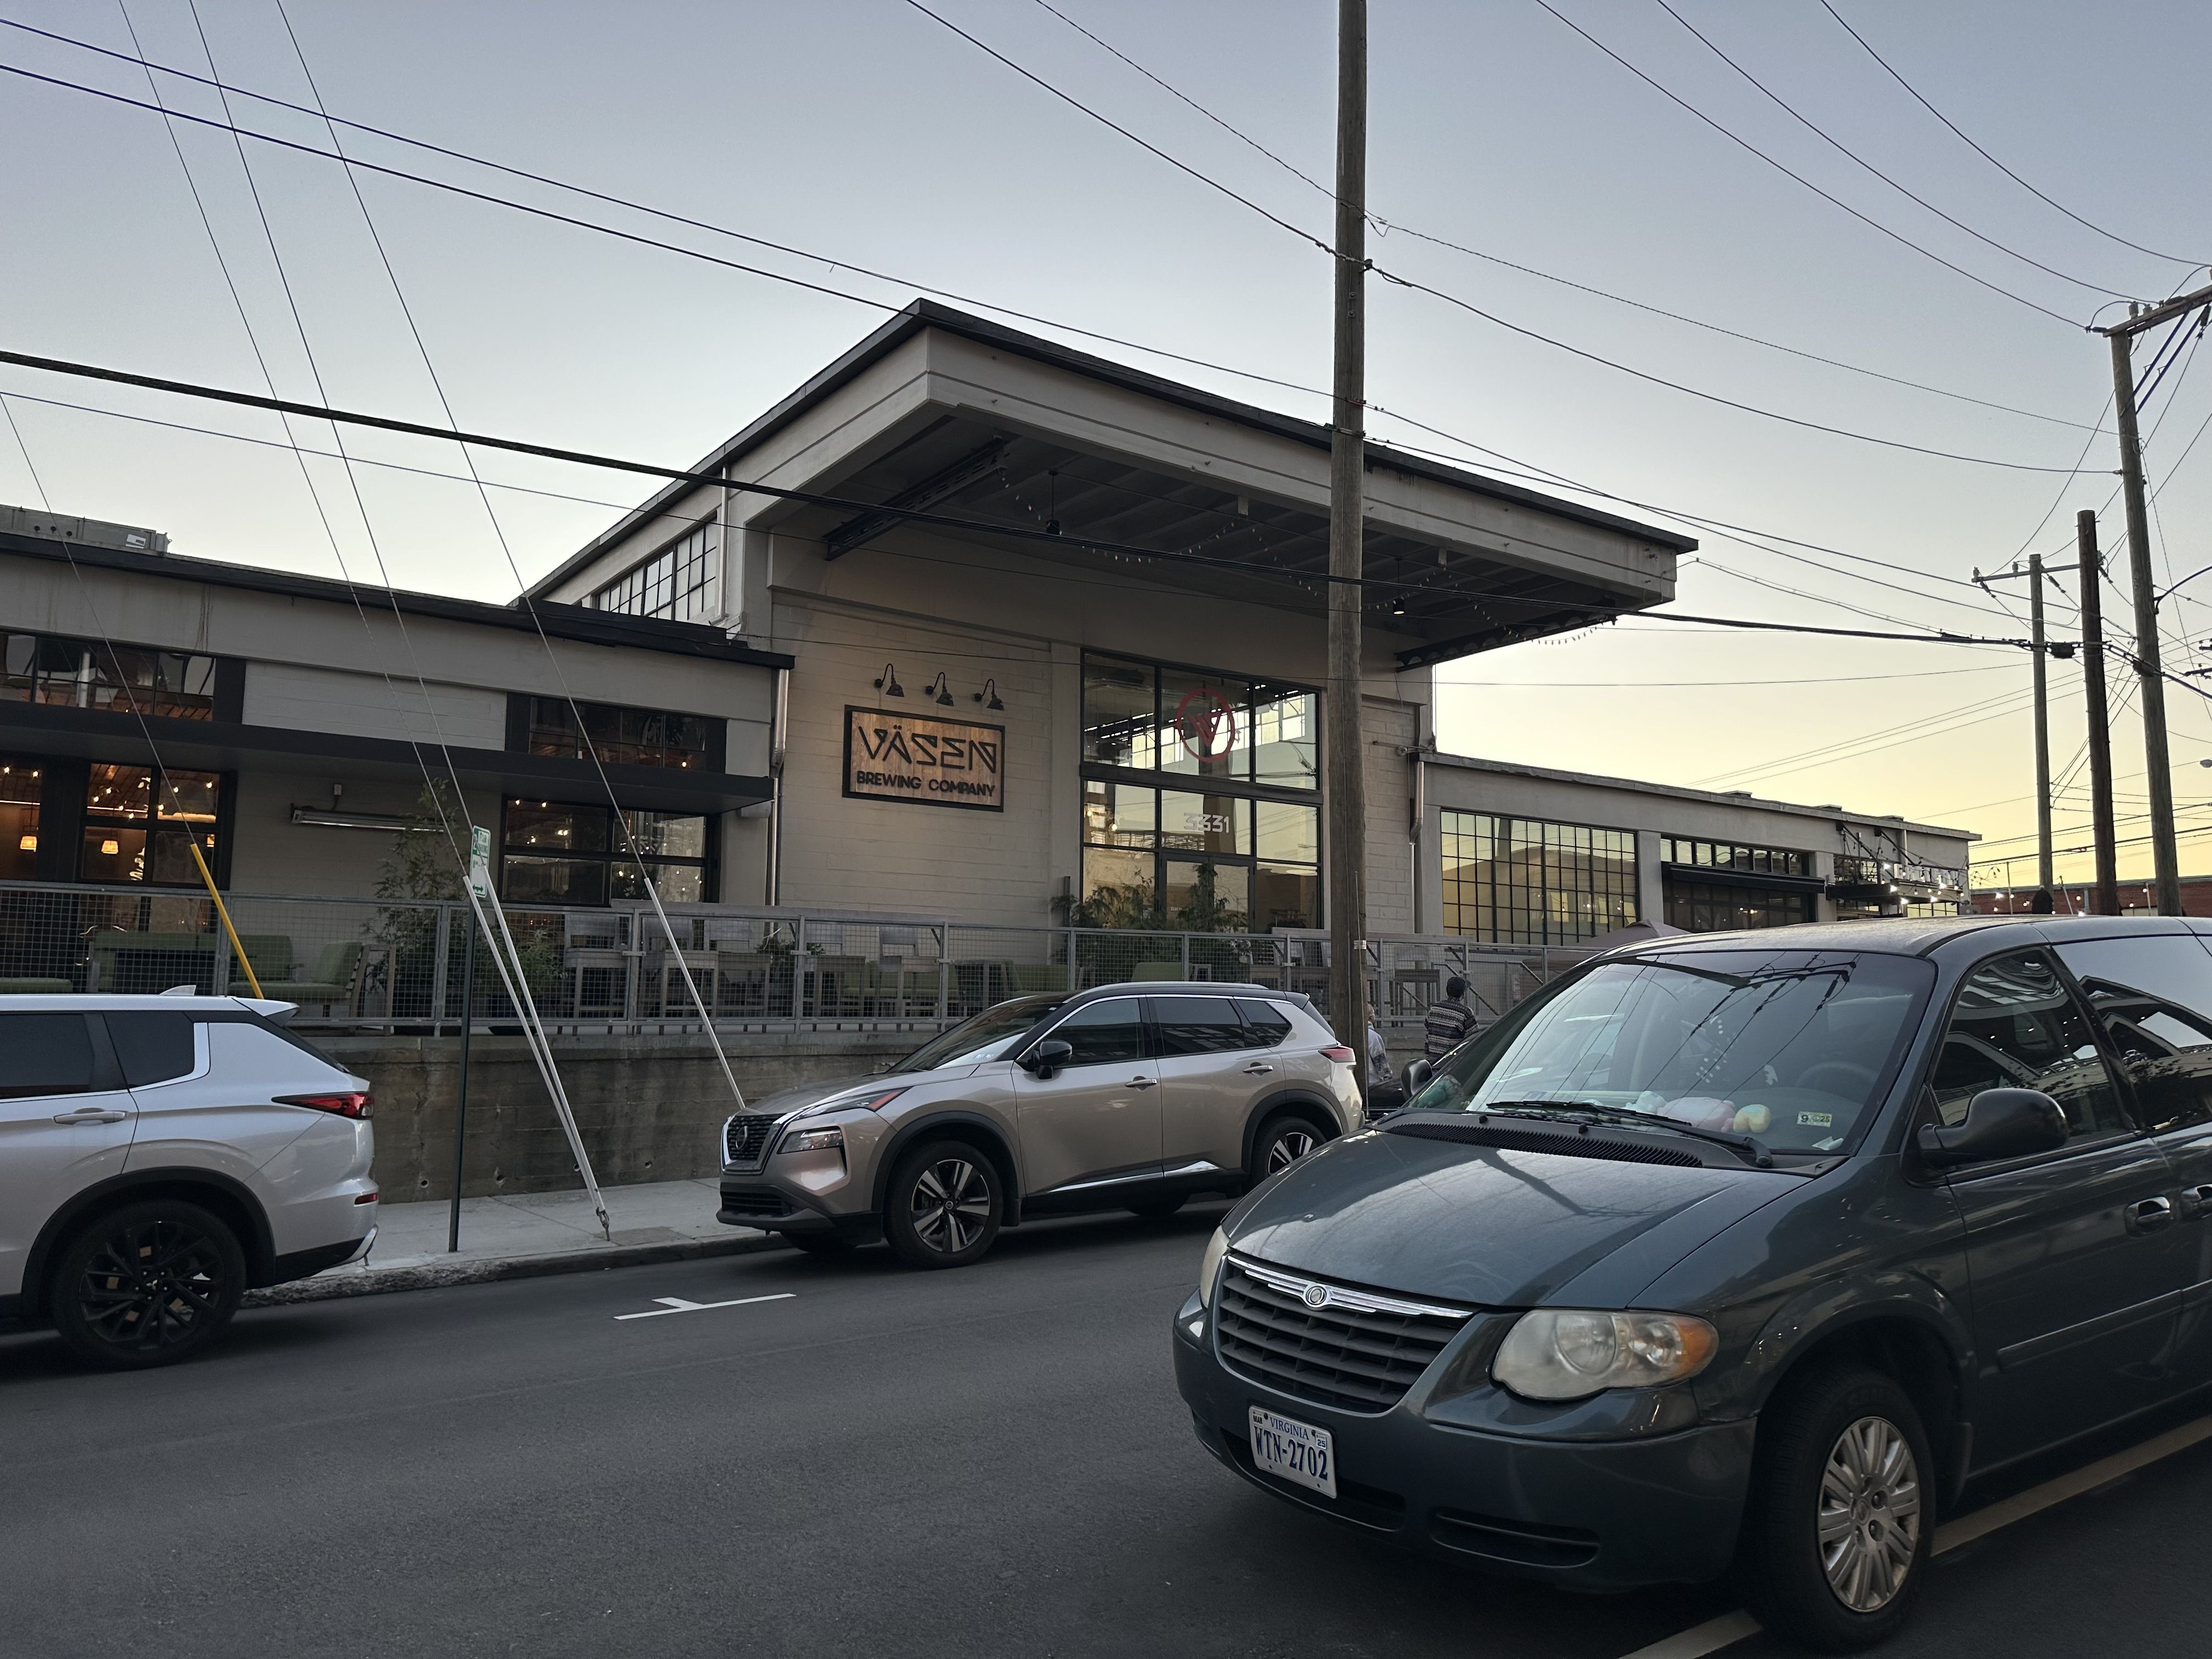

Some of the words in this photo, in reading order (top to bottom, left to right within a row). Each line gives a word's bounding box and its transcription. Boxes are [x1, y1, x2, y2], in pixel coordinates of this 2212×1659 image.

[858, 725, 997, 774] VÄSEN
[857, 771, 921, 789] BREWING
[929, 778, 995, 796] COMPANY
[1184, 813, 1229, 833] 3331
[1801, 1114, 1809, 1122] 9
[1270, 1417, 1310, 1440] VIRGINIA
[1254, 1425, 1328, 1481] WTN-2702
[1317, 1439, 1326, 1448] 25
